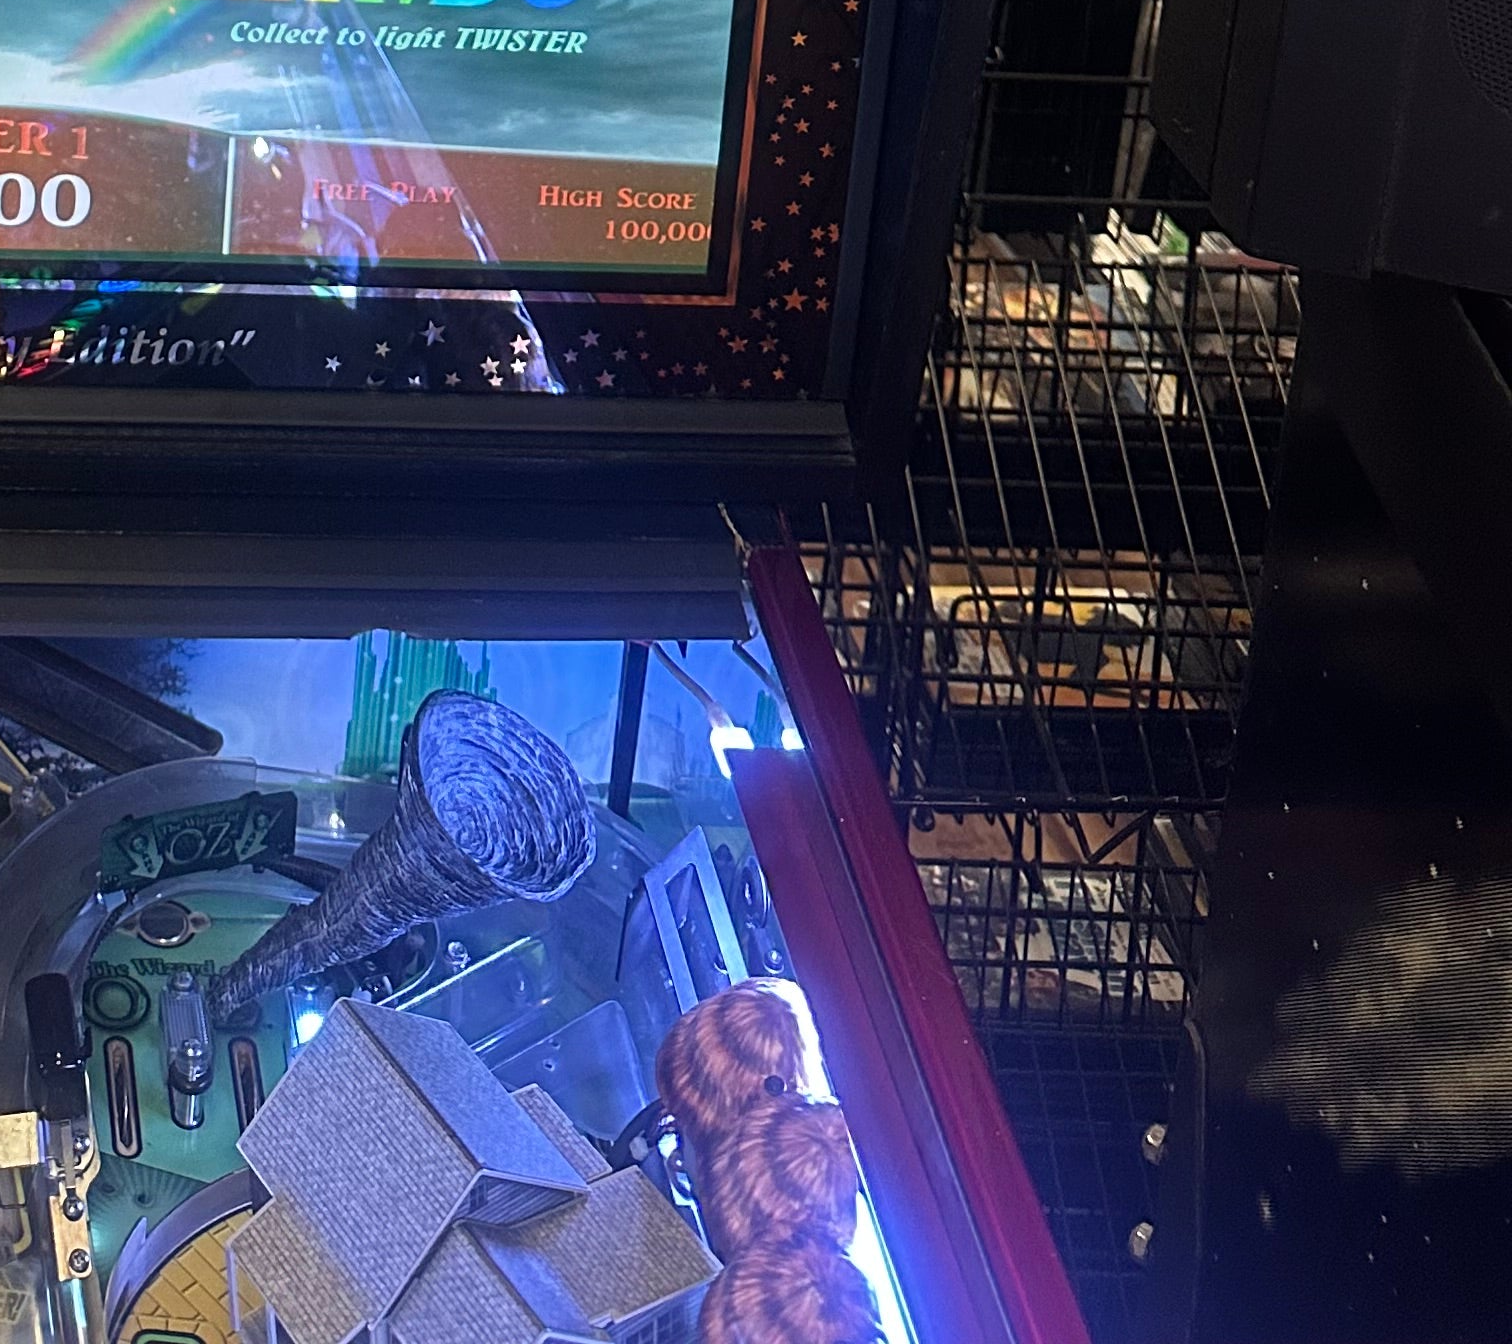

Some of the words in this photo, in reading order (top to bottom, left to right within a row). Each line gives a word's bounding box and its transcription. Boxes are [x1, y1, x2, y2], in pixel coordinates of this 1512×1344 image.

[229, 20, 328, 46] Collect
[335, 24, 367, 47] to
[374, 24, 446, 52] light
[454, 26, 589, 55] TWISTER
[72, 127, 89, 160] 1
